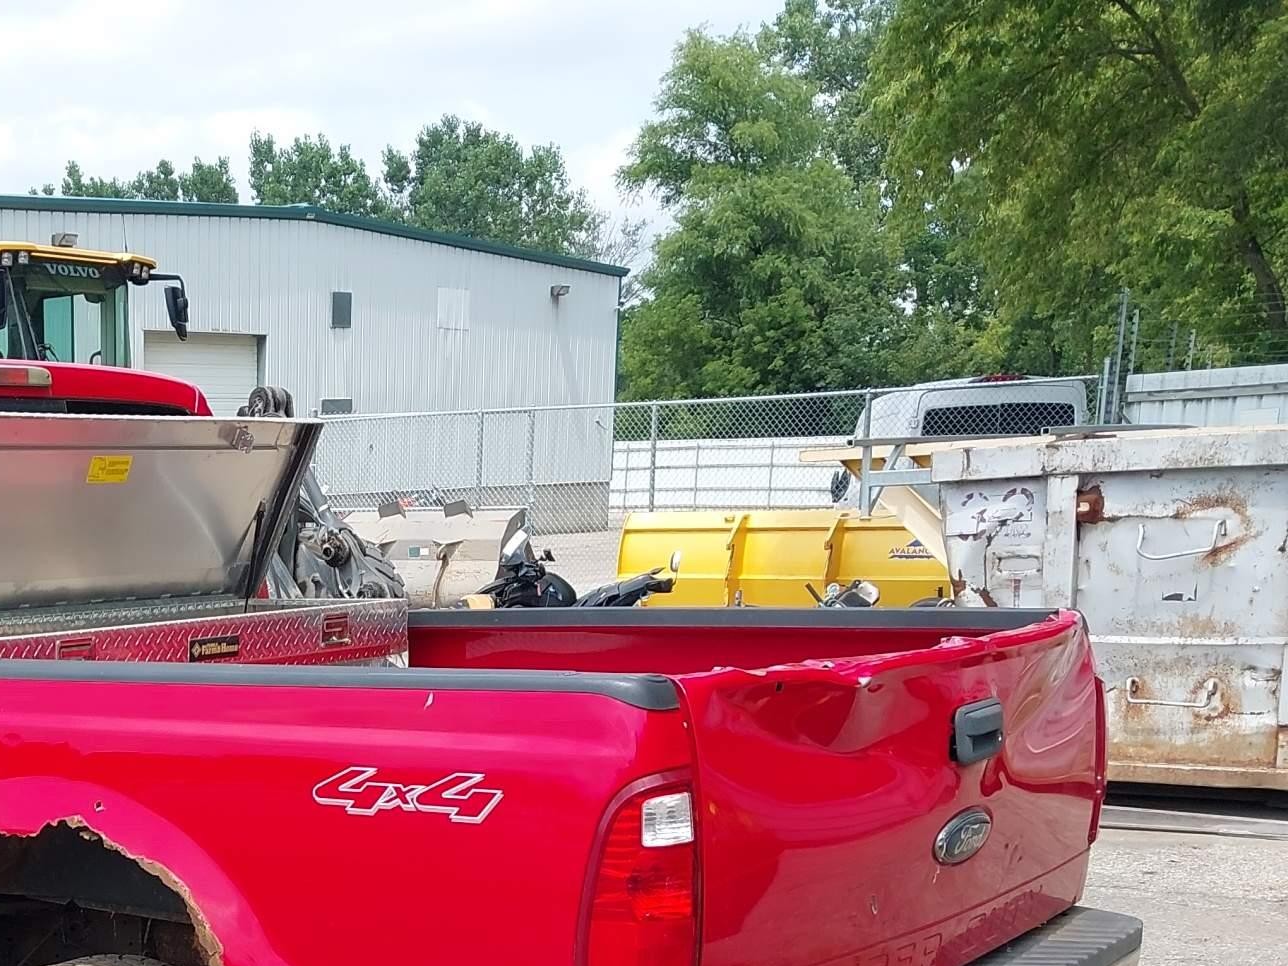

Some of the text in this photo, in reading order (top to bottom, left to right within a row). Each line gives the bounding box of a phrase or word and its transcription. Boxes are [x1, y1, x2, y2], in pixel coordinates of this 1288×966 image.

[42, 262, 100, 279] VOLVO
[888, 547, 932, 555] AVALANC
[312, 766, 504, 824] 4x4
[954, 822, 987, 855] Ford
